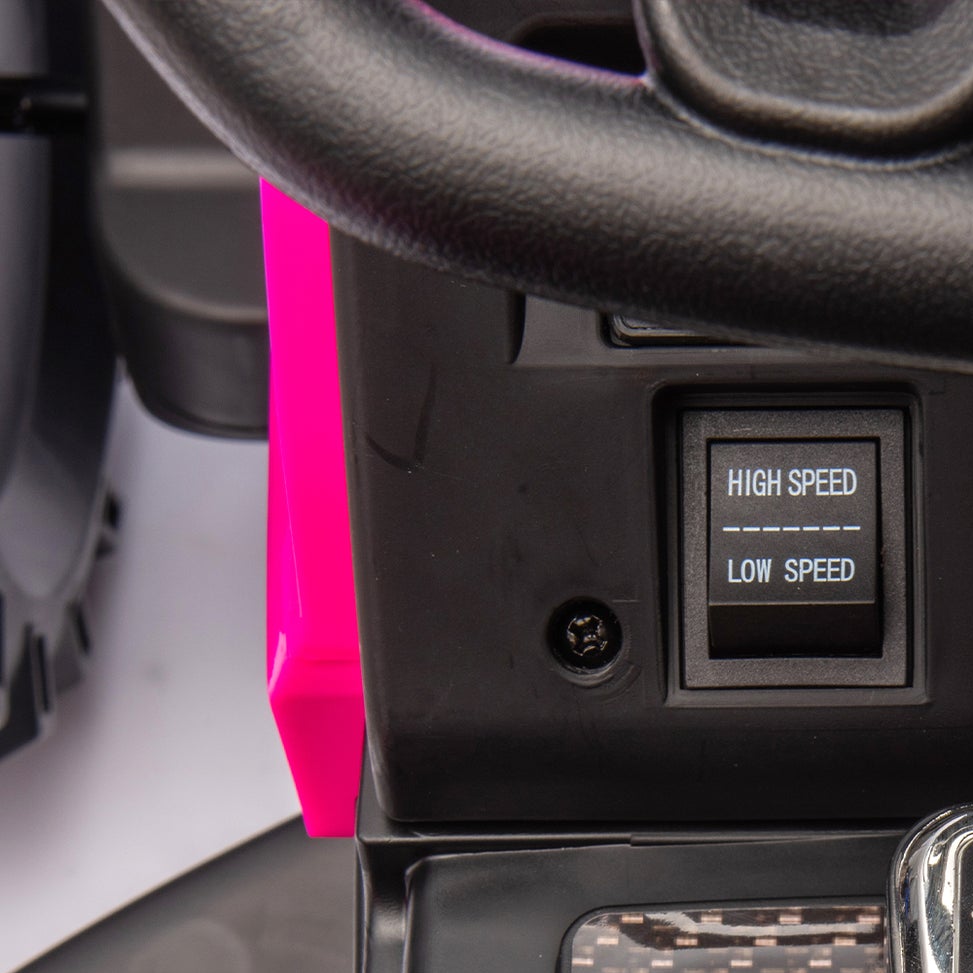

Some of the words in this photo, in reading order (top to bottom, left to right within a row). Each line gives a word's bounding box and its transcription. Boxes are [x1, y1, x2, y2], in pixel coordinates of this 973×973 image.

[728, 469, 781, 496] HIGH
[788, 468, 857, 496] SPEED
[728, 559, 772, 583] LOW
[784, 558, 855, 583] SPEED
